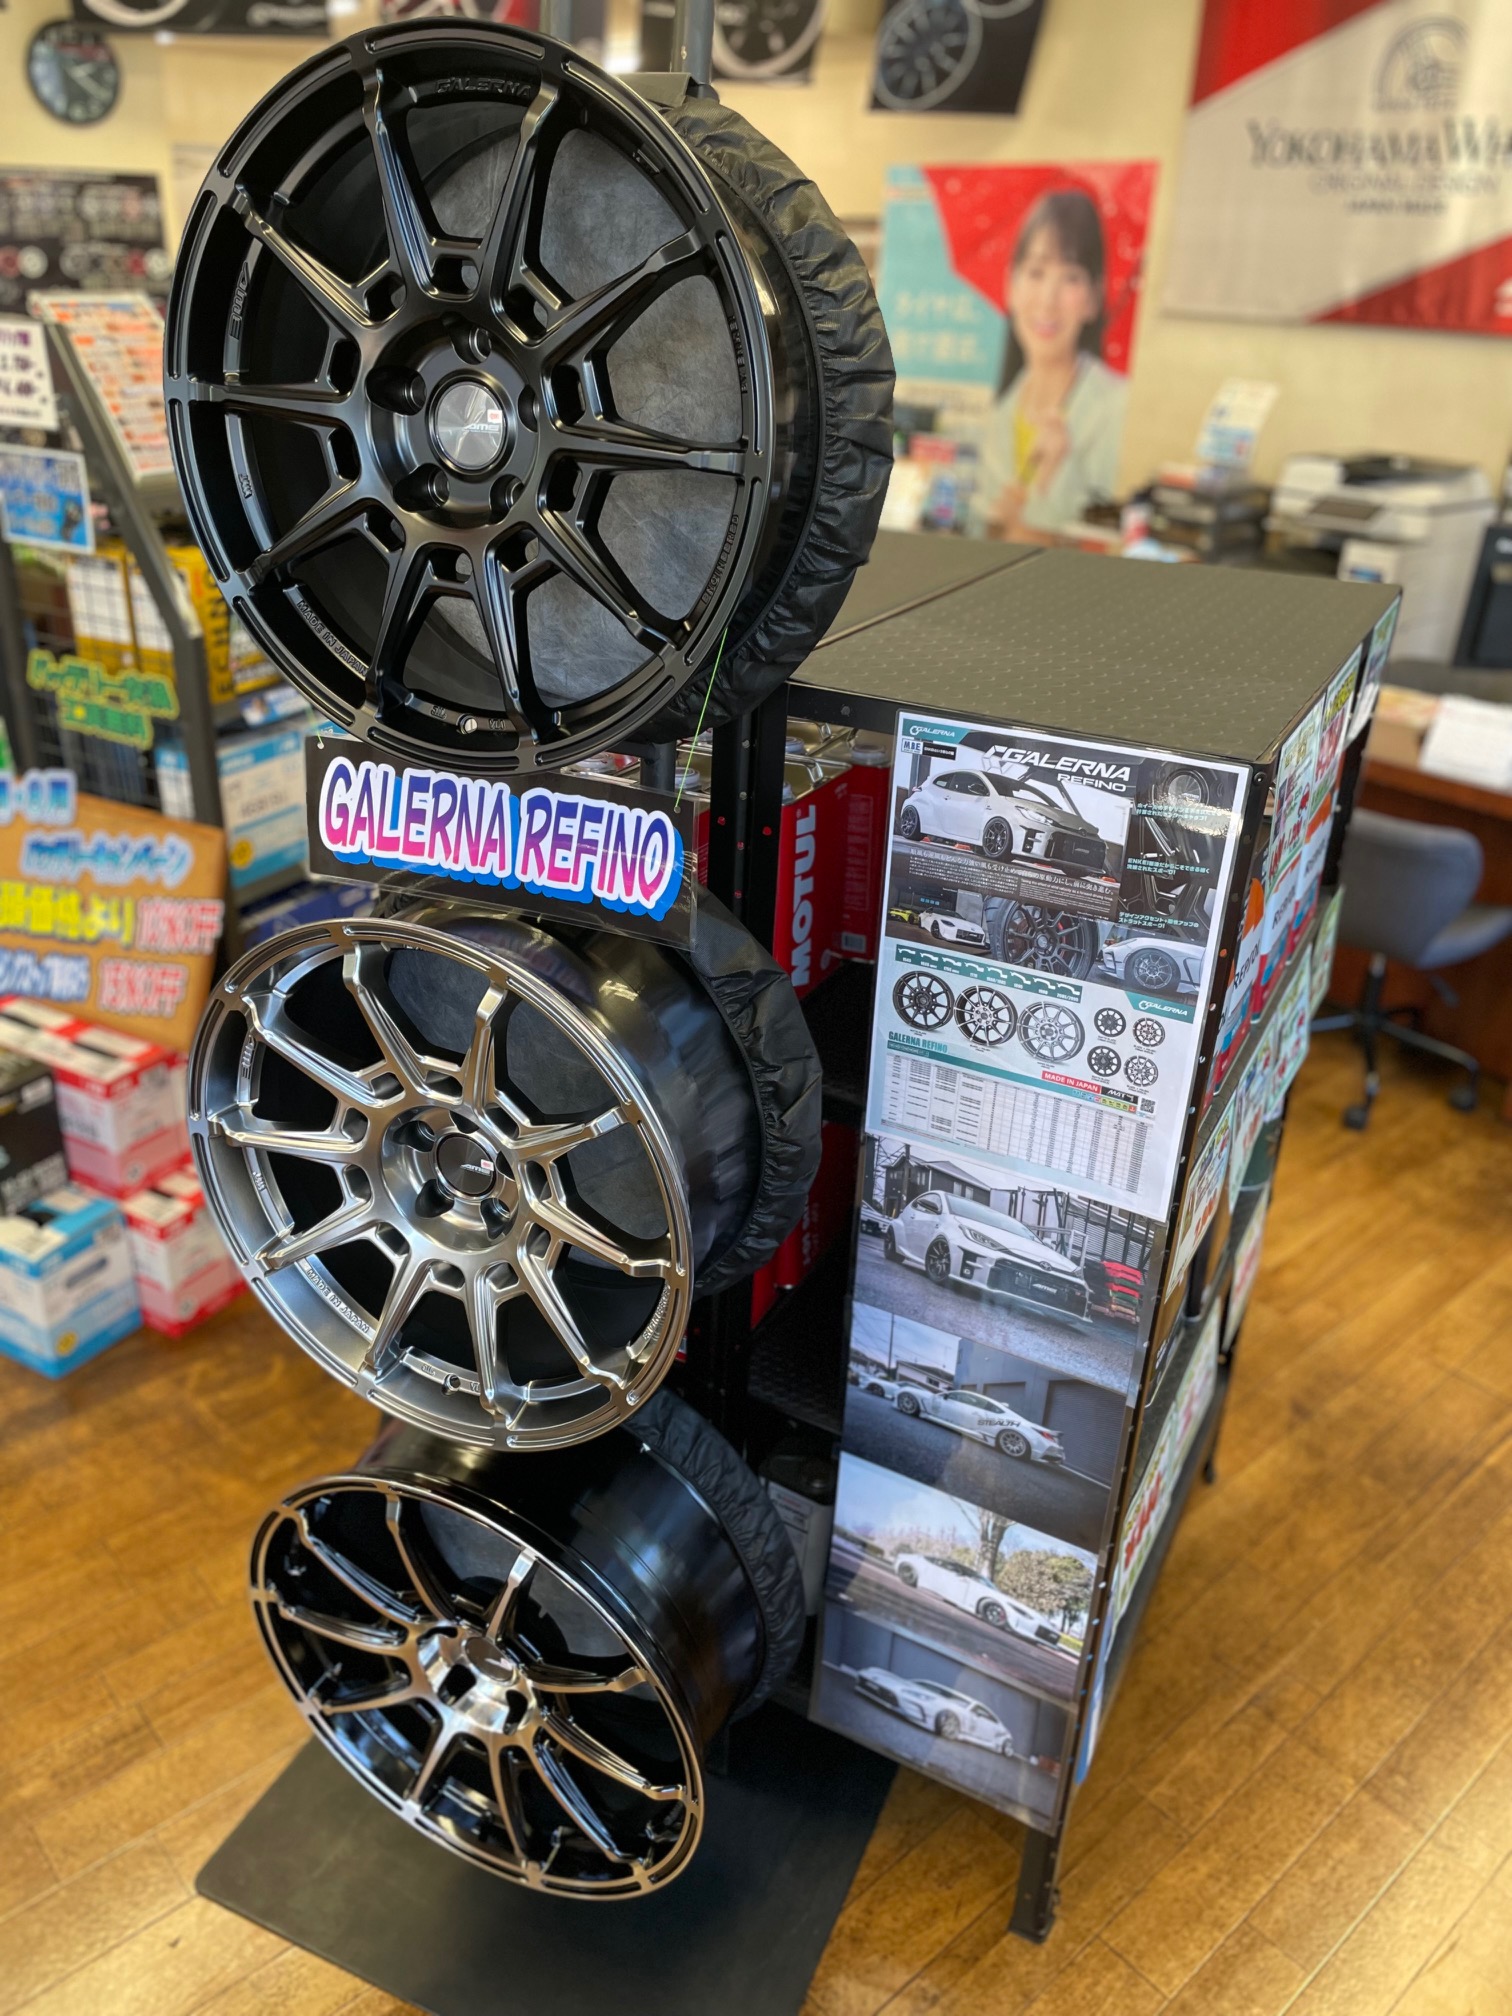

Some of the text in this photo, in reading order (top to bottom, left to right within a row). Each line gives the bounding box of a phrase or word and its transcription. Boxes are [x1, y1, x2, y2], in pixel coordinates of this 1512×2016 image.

[297, 599, 369, 676] MADE IN JAPAN
[1001, 748, 1131, 782] GALERNA
[1057, 773, 1127, 792] REFINO
[322, 760, 672, 906] GALERNA REFINO
[791, 805, 816, 987] MOTUL
[888, 1031, 921, 1048] GALERNA
[921, 1037, 949, 1054] REFINO
[1044, 1072, 1067, 1085] MADE
[1067, 1078, 1075, 1087] IN
[1075, 1080, 1098, 1092] JAPAN
[307, 1268, 370, 1334] MADE IN JAPAN
[977, 1418, 1021, 1428] STEALTH
